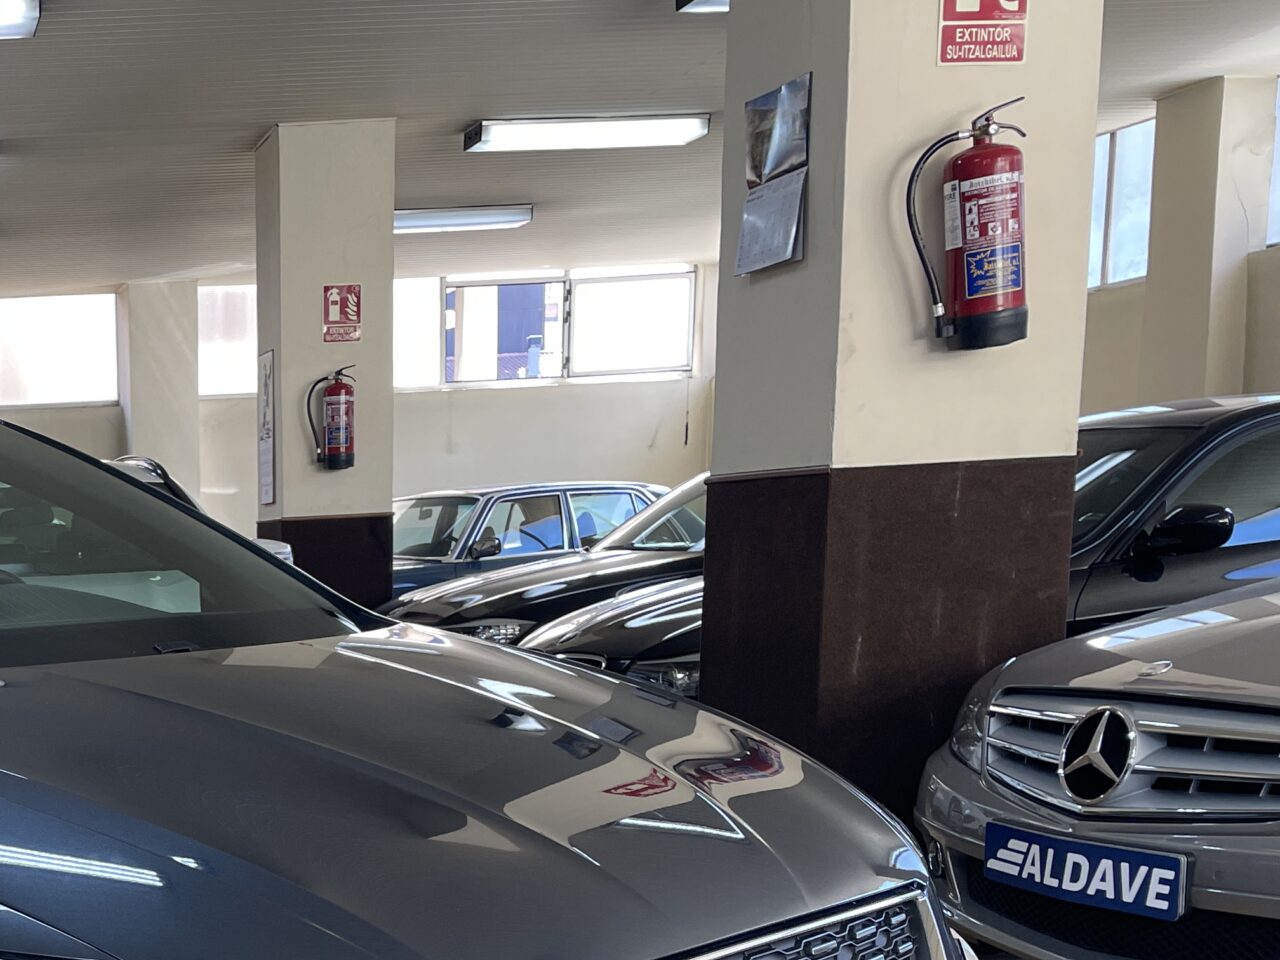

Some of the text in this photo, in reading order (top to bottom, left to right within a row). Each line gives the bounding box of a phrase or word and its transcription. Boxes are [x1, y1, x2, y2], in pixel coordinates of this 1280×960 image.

[956, 28, 1011, 42] EXTINTOR
[945, 45, 1018, 59] SU-ITZALGAILUA
[1021, 843, 1176, 910] ALDAVE
